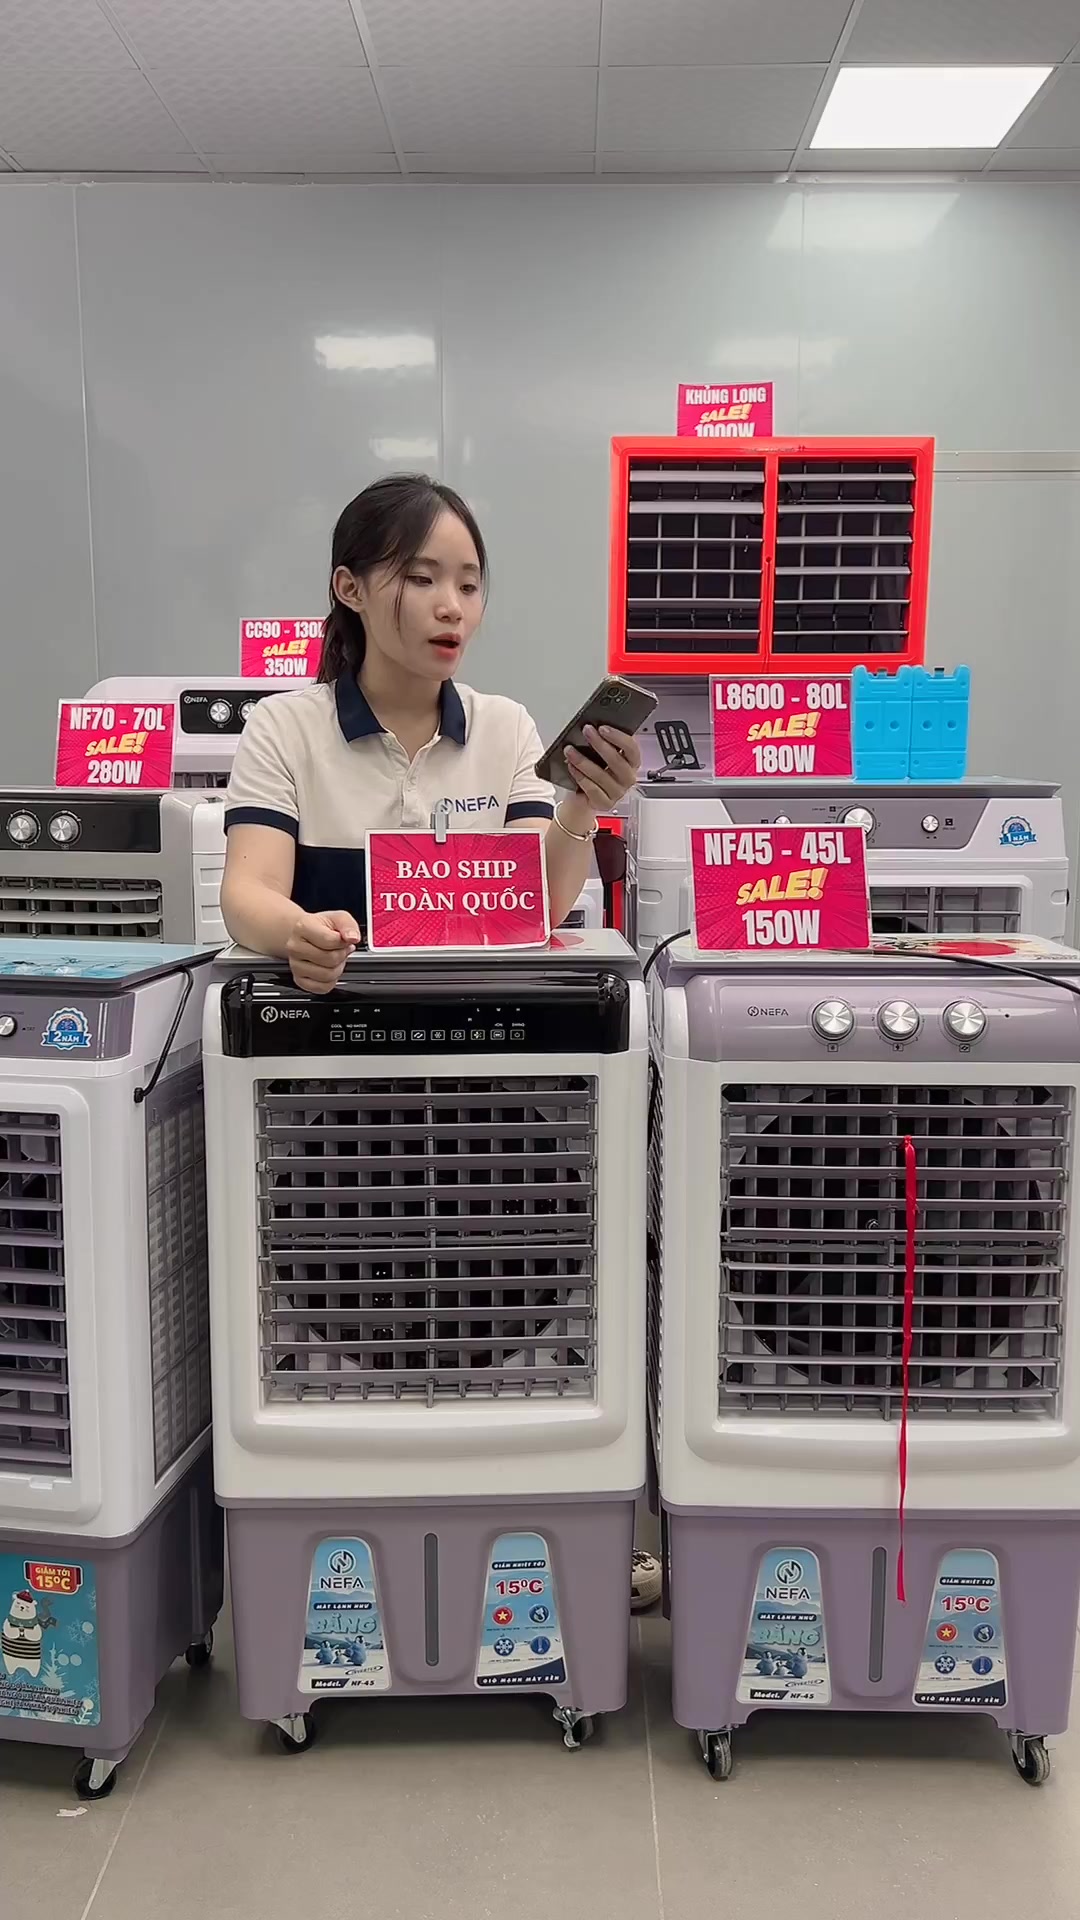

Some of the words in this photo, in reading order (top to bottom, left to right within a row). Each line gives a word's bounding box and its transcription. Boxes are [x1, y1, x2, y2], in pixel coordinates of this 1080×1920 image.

[685, 384, 729, 405] KHỦNG
[731, 387, 766, 403] LONG
[699, 403, 753, 424] SALE!
[245, 621, 281, 638] CC90
[262, 639, 310, 657] SALE!
[264, 657, 308, 676] 350W
[715, 683, 784, 710] L8600
[806, 682, 847, 710] 80L
[70, 707, 115, 730] NF70
[133, 707, 166, 731] 70L
[746, 711, 821, 742] SALE!
[84, 731, 149, 757] SALE!
[752, 745, 815, 773] 180W
[87, 760, 143, 784] 280W
[455, 795, 499, 813] NEFA
[1007, 833, 1012, 842] 1
[704, 832, 773, 866] NF45
[800, 831, 851, 865] 45L
[396, 860, 451, 879] BAO
[457, 860, 517, 879] SHIP
[735, 867, 828, 906] SALE!
[380, 888, 455, 911] TOÀN
[461, 885, 535, 916] QUỐC
[742, 909, 820, 946] 150W
[280, 1009, 310, 1019] NEFA
[760, 1007, 789, 1016] NEFA
[53, 1031, 62, 1042] 2
[320, 1577, 364, 1589] NEFA
[765, 1587, 810, 1600] NEFA
[312, 1612, 377, 1634] BĂNG
[754, 1623, 820, 1646] BĂNG
